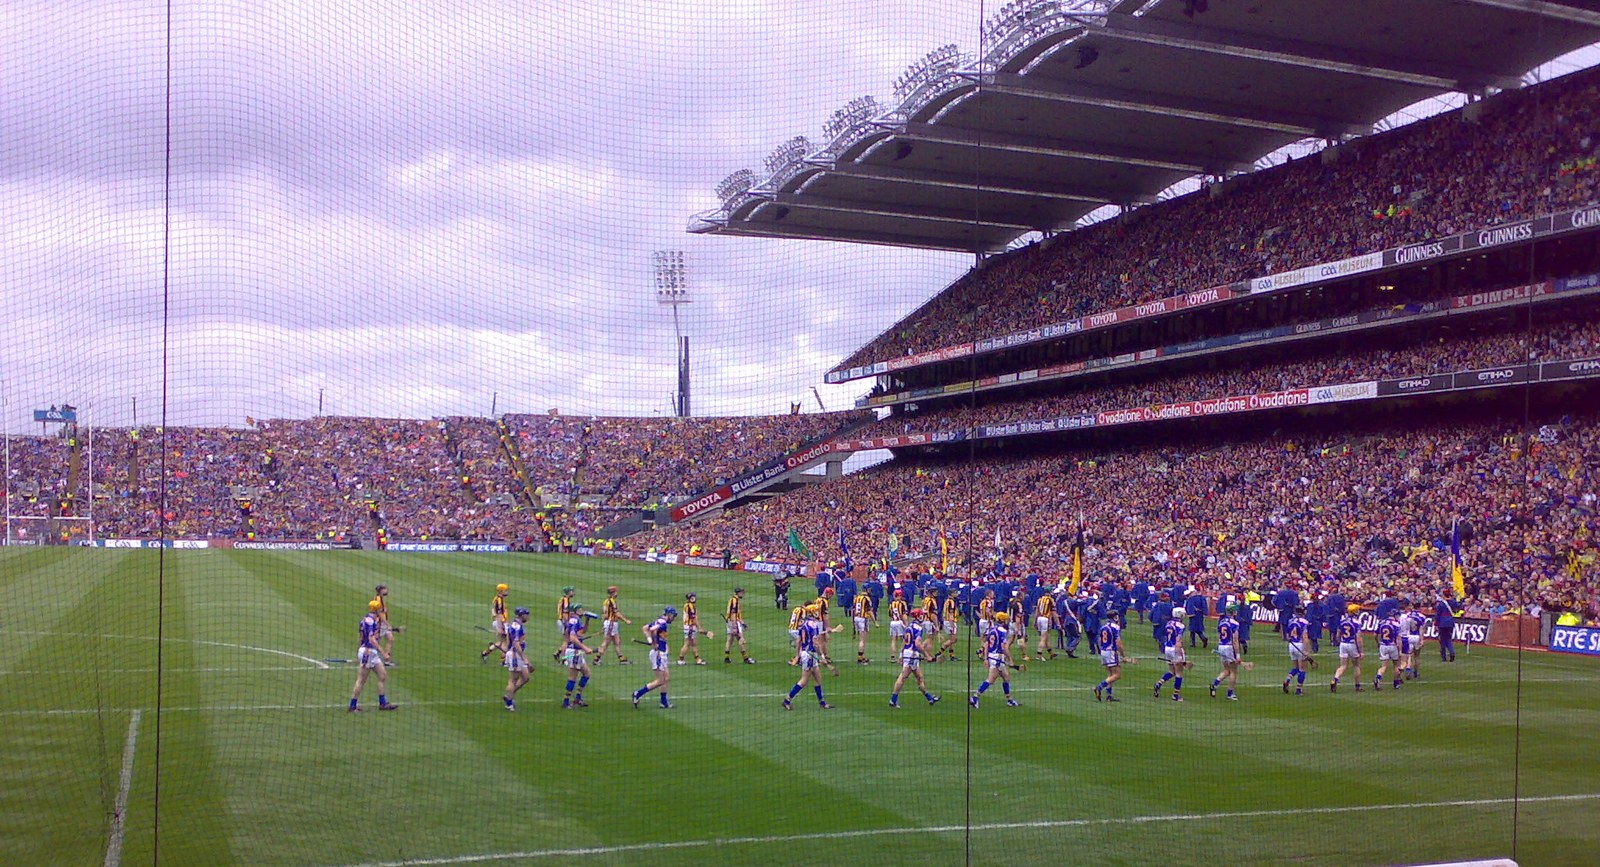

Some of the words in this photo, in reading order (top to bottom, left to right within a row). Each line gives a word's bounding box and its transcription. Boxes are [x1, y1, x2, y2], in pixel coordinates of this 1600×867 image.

[1479, 222, 1532, 247] GUINNESS
[1395, 241, 1444, 264] GUINNESS
[1338, 258, 1373, 273] MUSEUM
[1274, 272, 1306, 287] MUSEUM
[1185, 290, 1219, 306] TOYOTA
[1472, 282, 1546, 306] DIMPLEX
[1135, 302, 1165, 316] TOYOTA
[1090, 312, 1118, 327] TOYOTA
[1478, 369, 1514, 381] ETIHAD
[1399, 378, 1430, 388] ETIHAD
[1259, 391, 1307, 408] vodafone
[1333, 386, 1369, 398] MUSEUM
[1203, 399, 1246, 414] vodafone
[1064, 419, 1080, 428] Ulster
[1081, 415, 1095, 426] Bank
[1105, 410, 1141, 423] vodafone
[740, 473, 764, 490] Ulster
[764, 464, 786, 479] Bank
[681, 492, 722, 516] TOYOTA
[1101, 630, 1108, 644] 8
[1220, 627, 1228, 640] 5
[1290, 626, 1297, 638] 4
[1343, 625, 1351, 639] 3
[1382, 628, 1390, 640] 2
[1553, 629, 1588, 650] RTÉ
